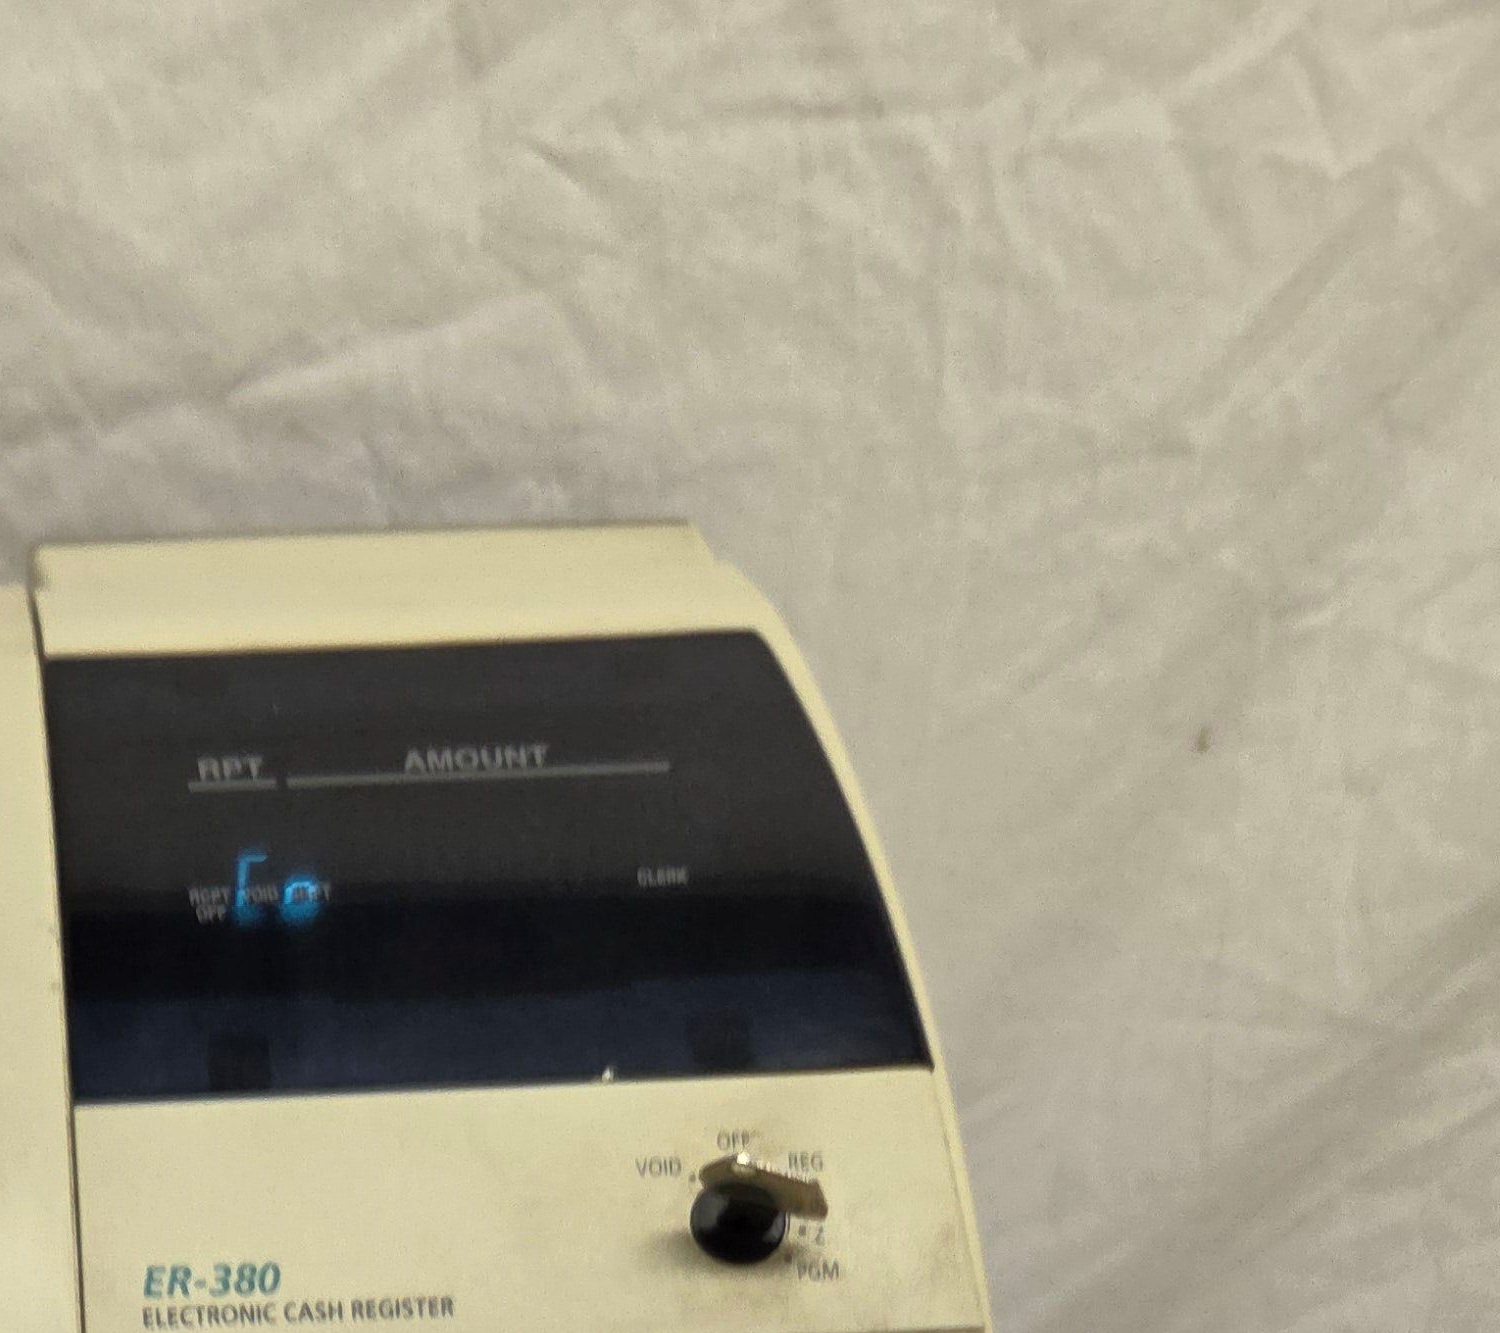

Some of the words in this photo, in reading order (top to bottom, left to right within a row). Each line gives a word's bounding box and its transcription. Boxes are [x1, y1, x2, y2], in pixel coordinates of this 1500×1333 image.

[403, 742, 551, 776] AMOUNT
[716, 1130, 751, 1151] OFF
[635, 1156, 683, 1179] VOID
[788, 1150, 824, 1173] REG
[142, 1261, 282, 1299] ER-380
[796, 1257, 841, 1283] PGM
[141, 1302, 278, 1331] ELECTRONIC
[283, 1299, 344, 1325] CASH
[350, 1294, 456, 1321] REGISTER
